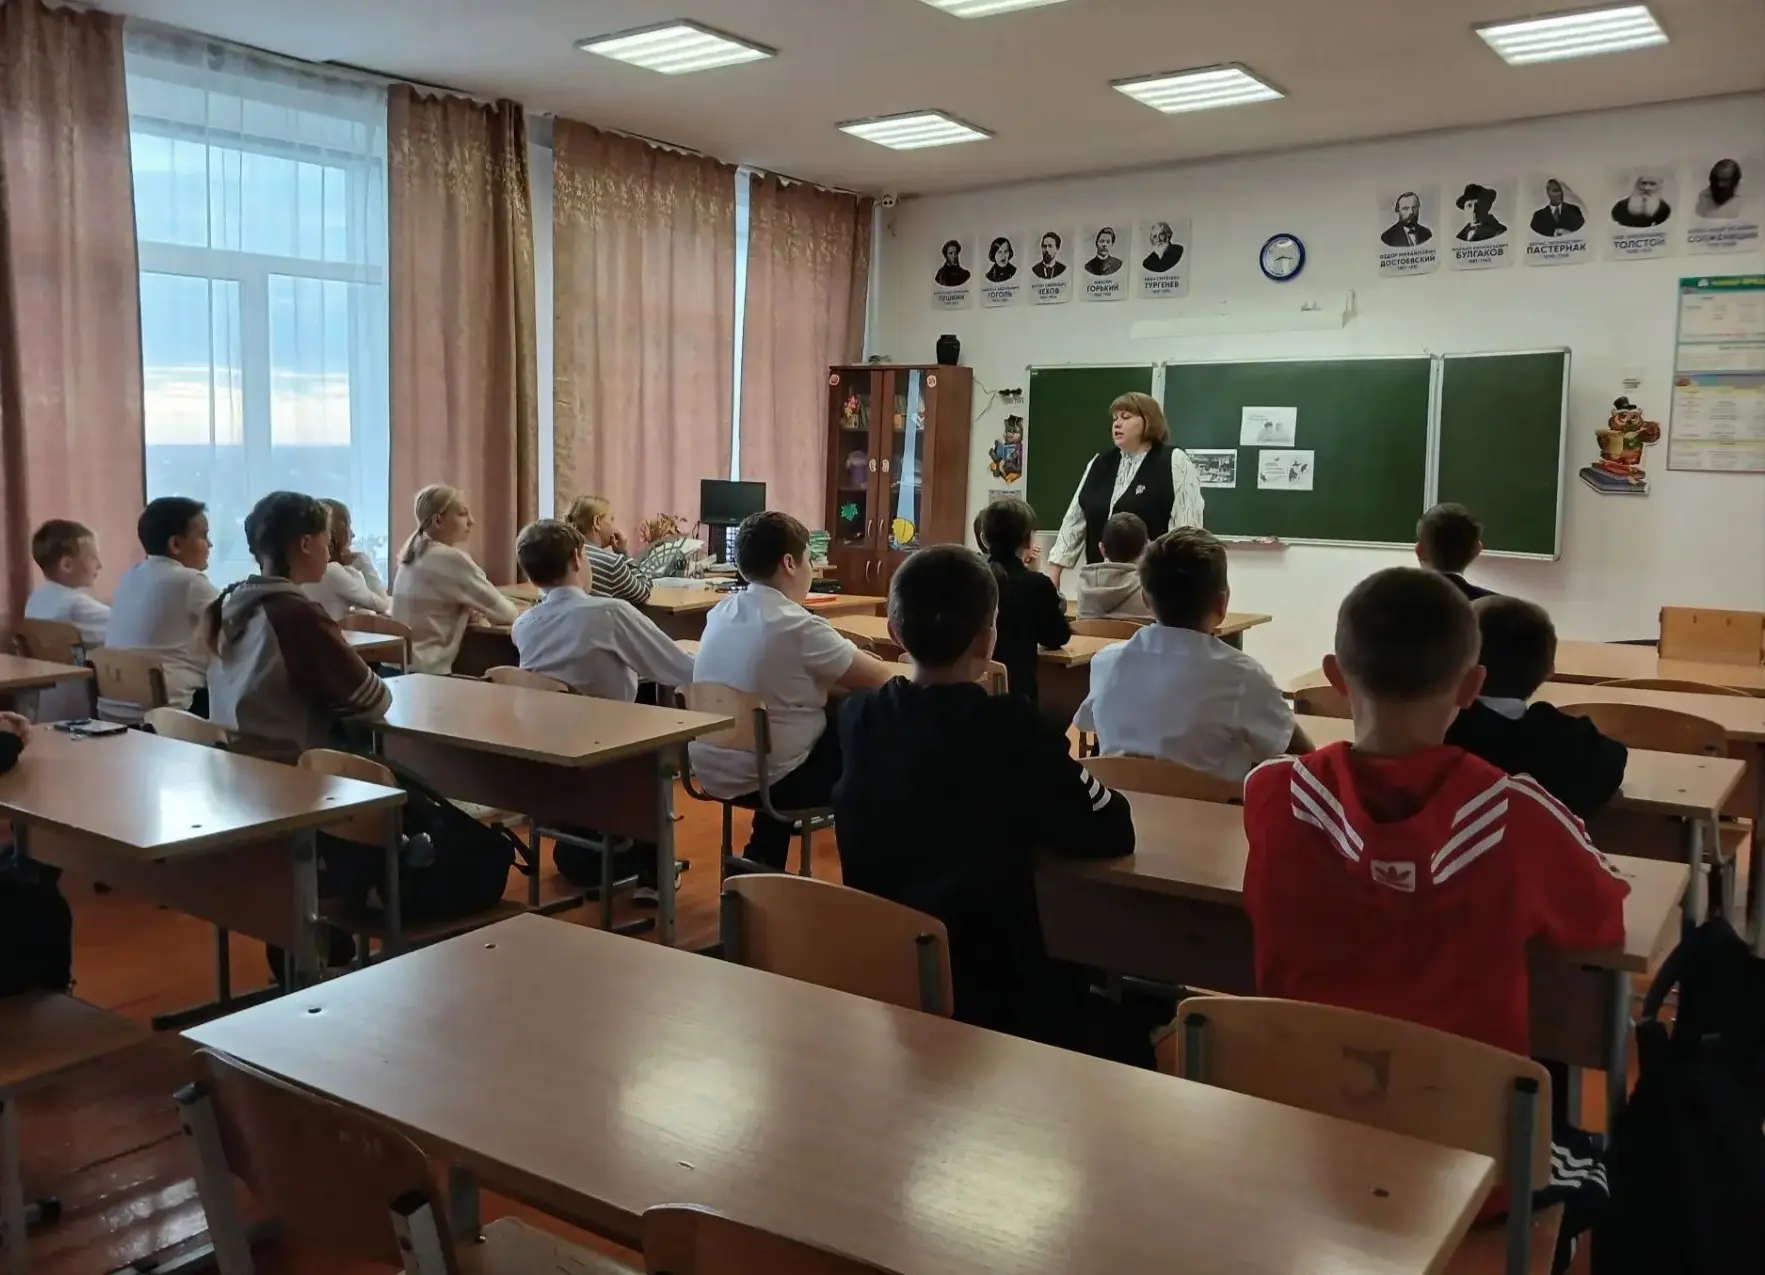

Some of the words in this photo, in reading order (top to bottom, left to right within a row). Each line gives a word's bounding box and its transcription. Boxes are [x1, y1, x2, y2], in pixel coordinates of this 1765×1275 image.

[1526, 242, 1587, 254] ПАСТЕРНАК
[1613, 238, 1666, 249] ТОЛСТОЙ
[1456, 248, 1504, 260] БУЛГАКОВ
[1380, 254, 1436, 268] ДОСТОЕВСКИЙ
[1086, 283, 1119, 293] ГОРЬКИЙ
[1144, 281, 1180, 289] ТУРГЕНЕВ
[1037, 287, 1060, 296] ЧЕХОВ
